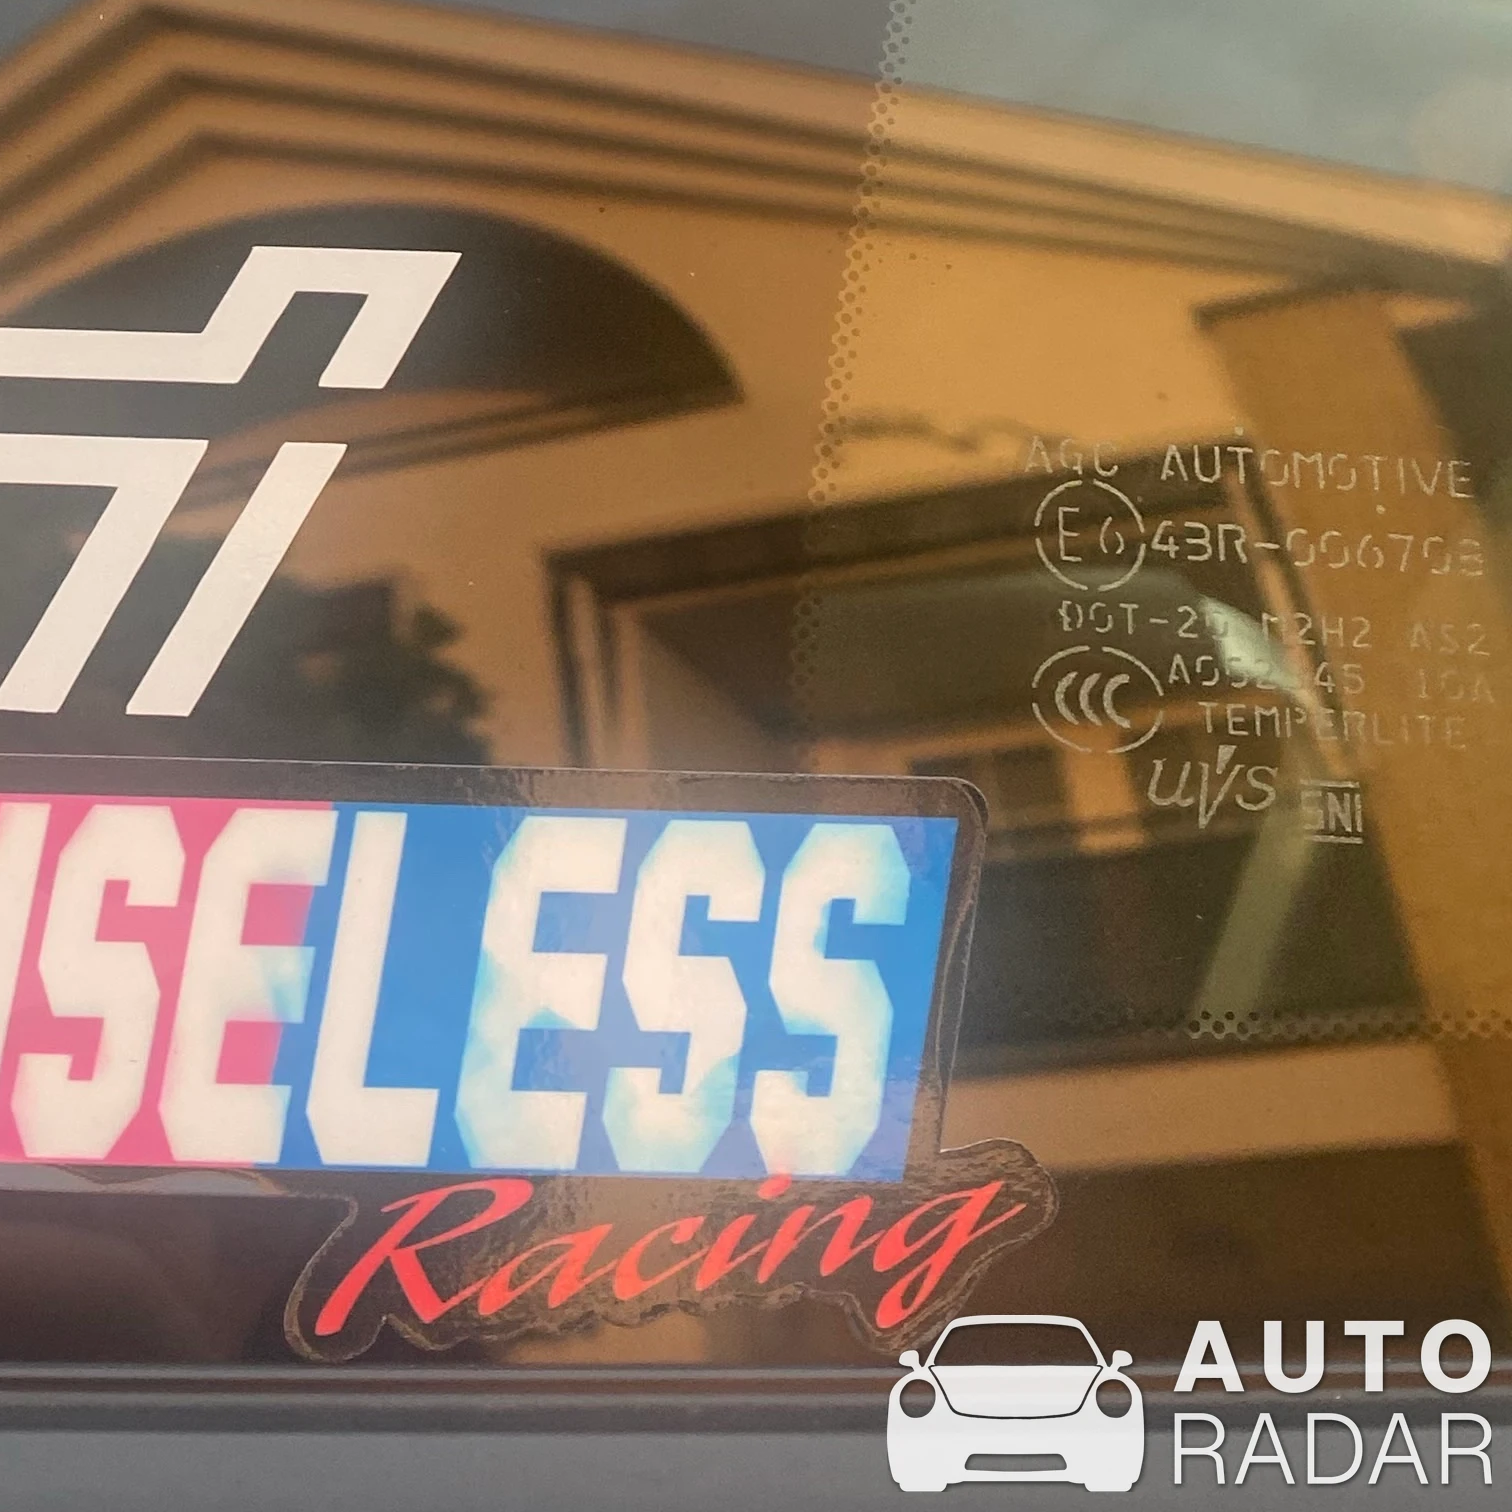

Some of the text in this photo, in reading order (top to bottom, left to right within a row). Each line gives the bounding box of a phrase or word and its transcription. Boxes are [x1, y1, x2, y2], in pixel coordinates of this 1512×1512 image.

[1024, 434, 1475, 500] AGC AUTOMOTIVE
[1410, 622, 1492, 658] AS2
[1198, 700, 1467, 752] TEMPERLITE
[314, 1173, 1027, 1331] Racing
